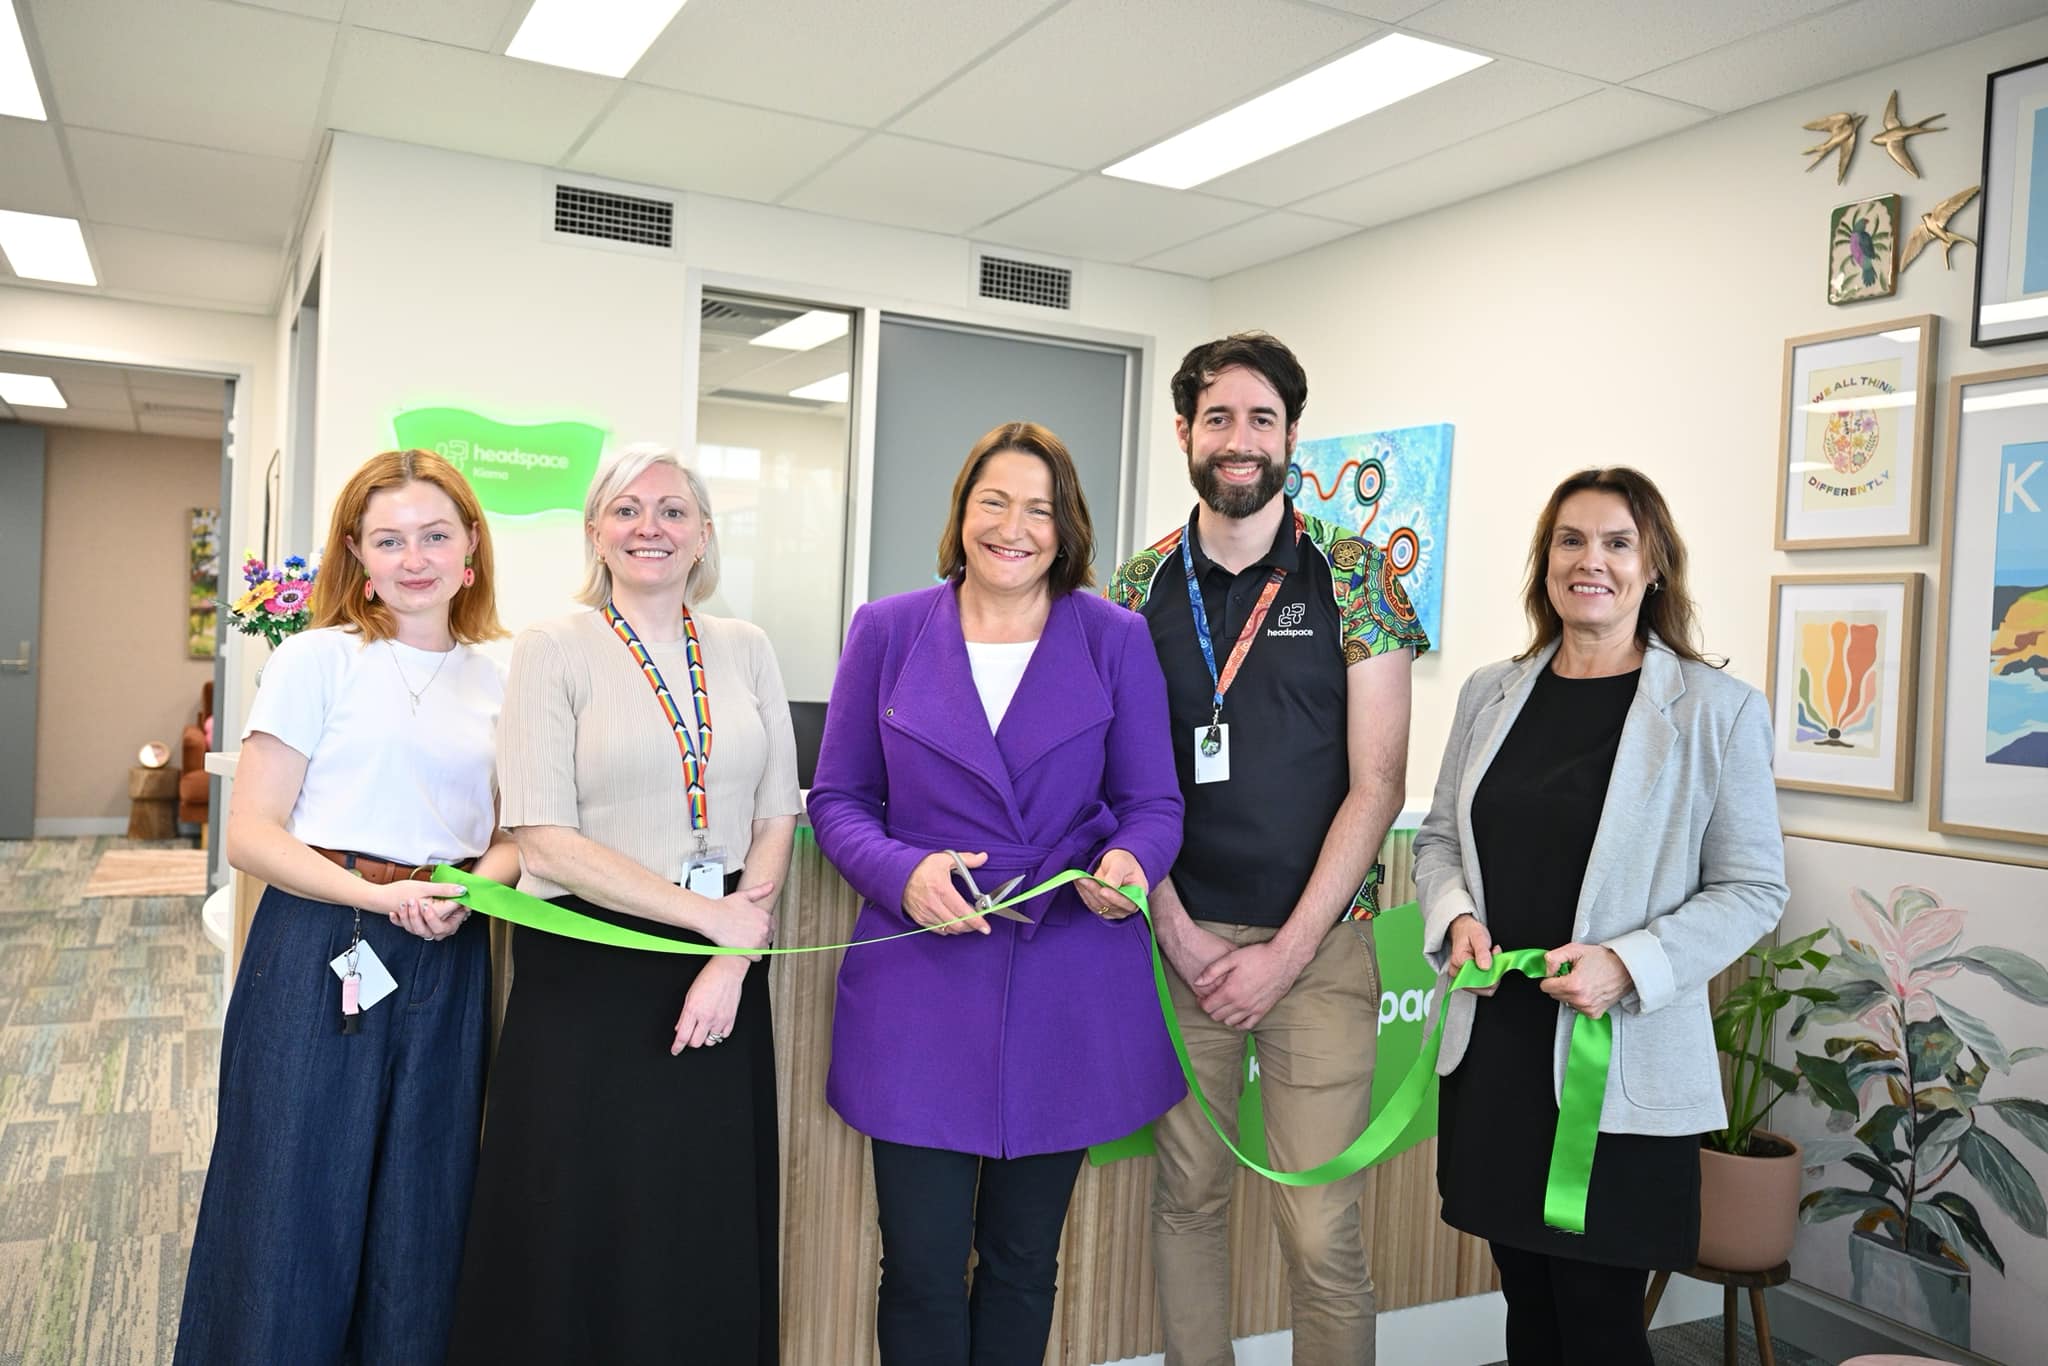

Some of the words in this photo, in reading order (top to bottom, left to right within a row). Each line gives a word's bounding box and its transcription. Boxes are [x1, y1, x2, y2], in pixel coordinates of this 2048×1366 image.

[1811, 386, 1832, 404] WE
[1833, 377, 1857, 392] ALL
[1860, 376, 1896, 395] THINK
[473, 443, 569, 471] headspace
[1808, 470, 1889, 497] DIFFERENTLY
[1267, 628, 1314, 638] headspace
